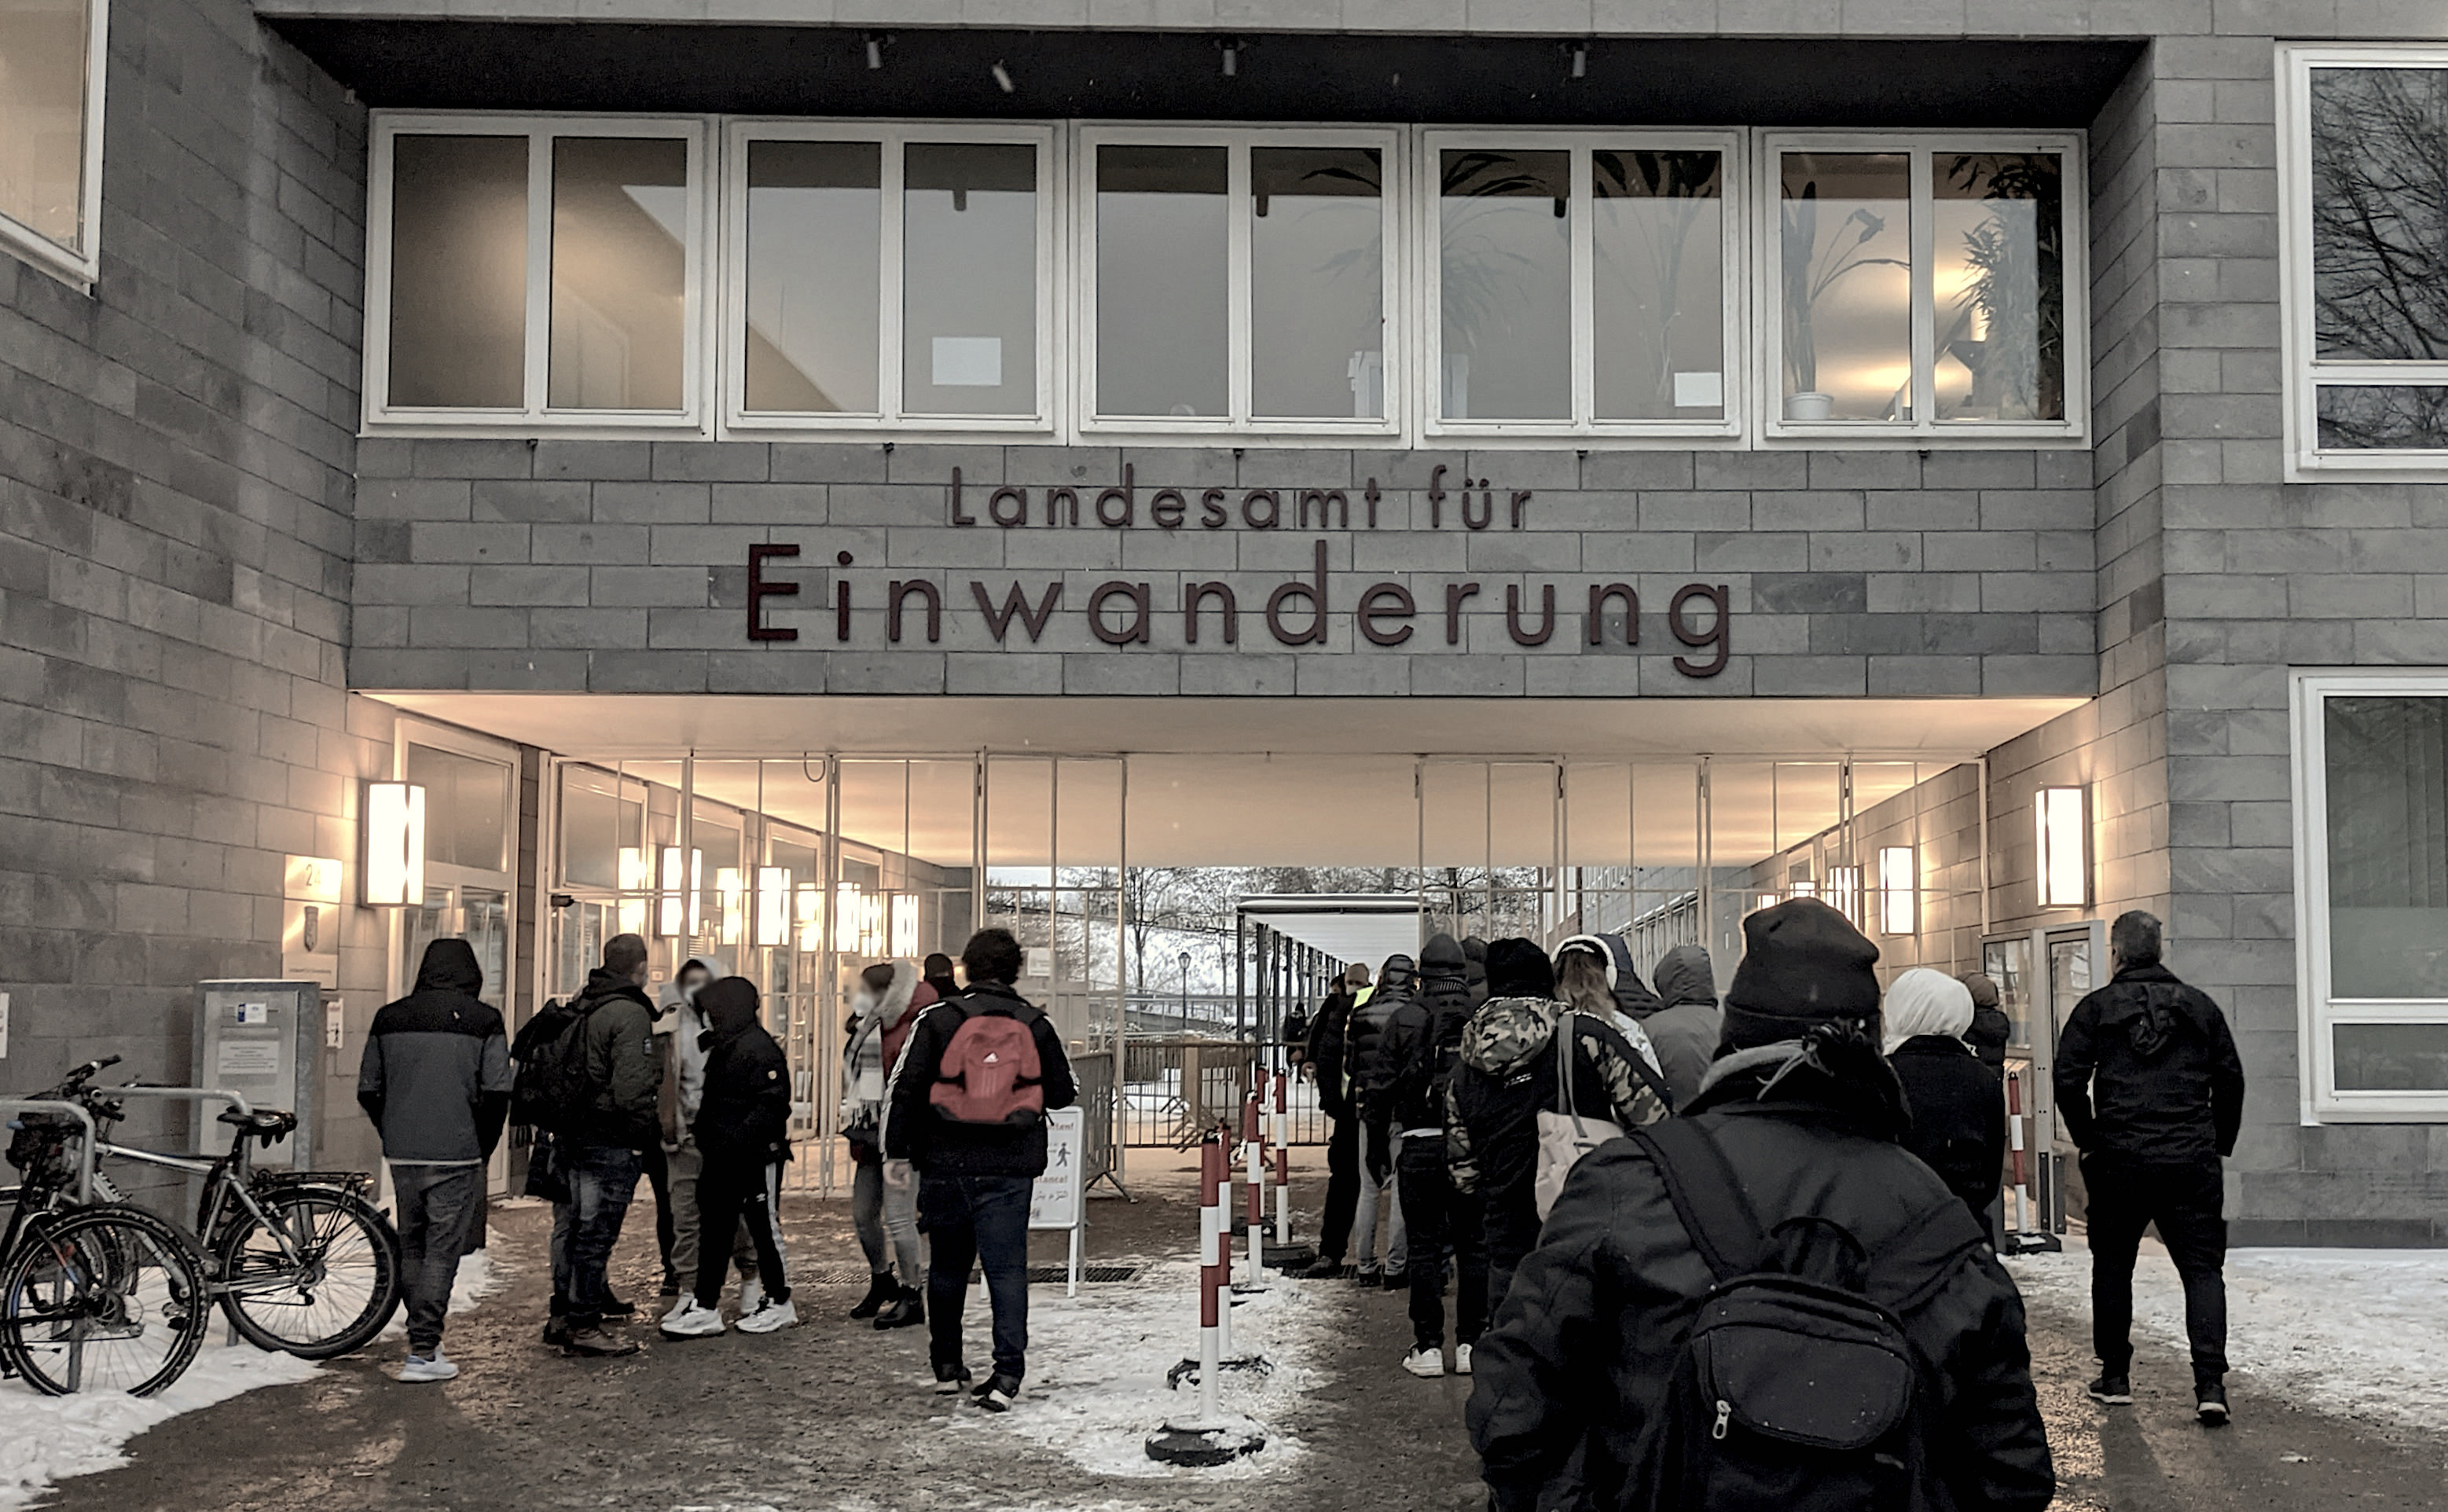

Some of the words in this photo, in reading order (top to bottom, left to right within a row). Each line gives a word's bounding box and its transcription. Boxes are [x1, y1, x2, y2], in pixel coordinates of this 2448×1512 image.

[951, 462, 1380, 528] Landesamt
[1427, 464, 1534, 530] für
[746, 540, 1732, 679] Einwanderung
